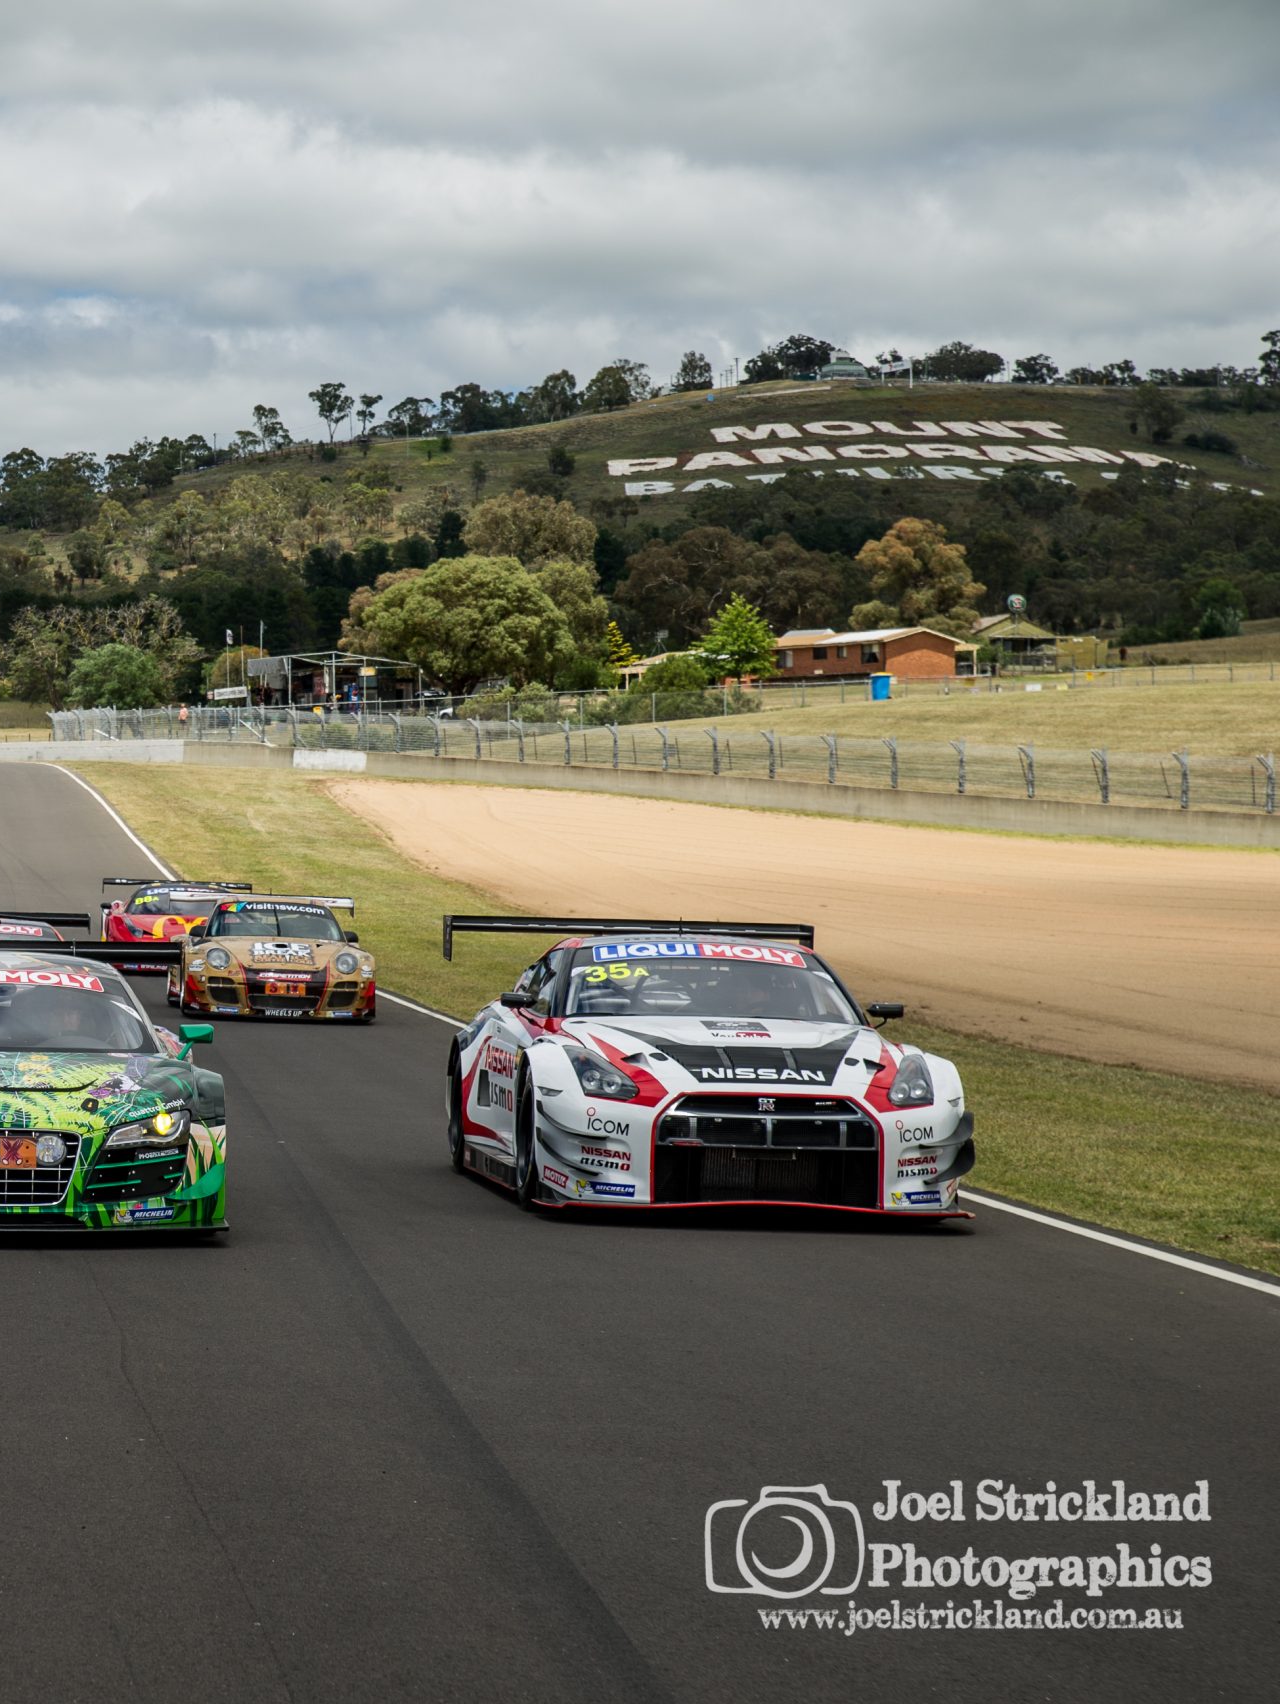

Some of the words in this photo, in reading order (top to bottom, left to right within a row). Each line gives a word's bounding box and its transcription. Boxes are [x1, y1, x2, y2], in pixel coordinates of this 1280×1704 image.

[709, 420, 1068, 443] MOUNT
[607, 443, 1196, 476] PANORAMA
[245, 903, 325, 915] visitnsw.com
[600, 943, 696, 959] LIQUI
[703, 944, 798, 964] MOLY
[265, 1009, 291, 1017] WHEELS
[484, 1043, 515, 1080] NISSAN
[701, 1067, 826, 1082] NISSAN
[490, 1080, 513, 1112] ismo
[129, 1105, 160, 1118] quattro
[161, 1098, 186, 1110] GmbH
[581, 1145, 631, 1161] NISSAN
[580, 1157, 630, 1171] nismo
[897, 1155, 937, 1168] NISSAN
[544, 1168, 566, 1186] MOTUL
[897, 1167, 937, 1178] nismo
[596, 1184, 635, 1193] MICHELIN
[134, 1209, 174, 1218] MICHELIN
